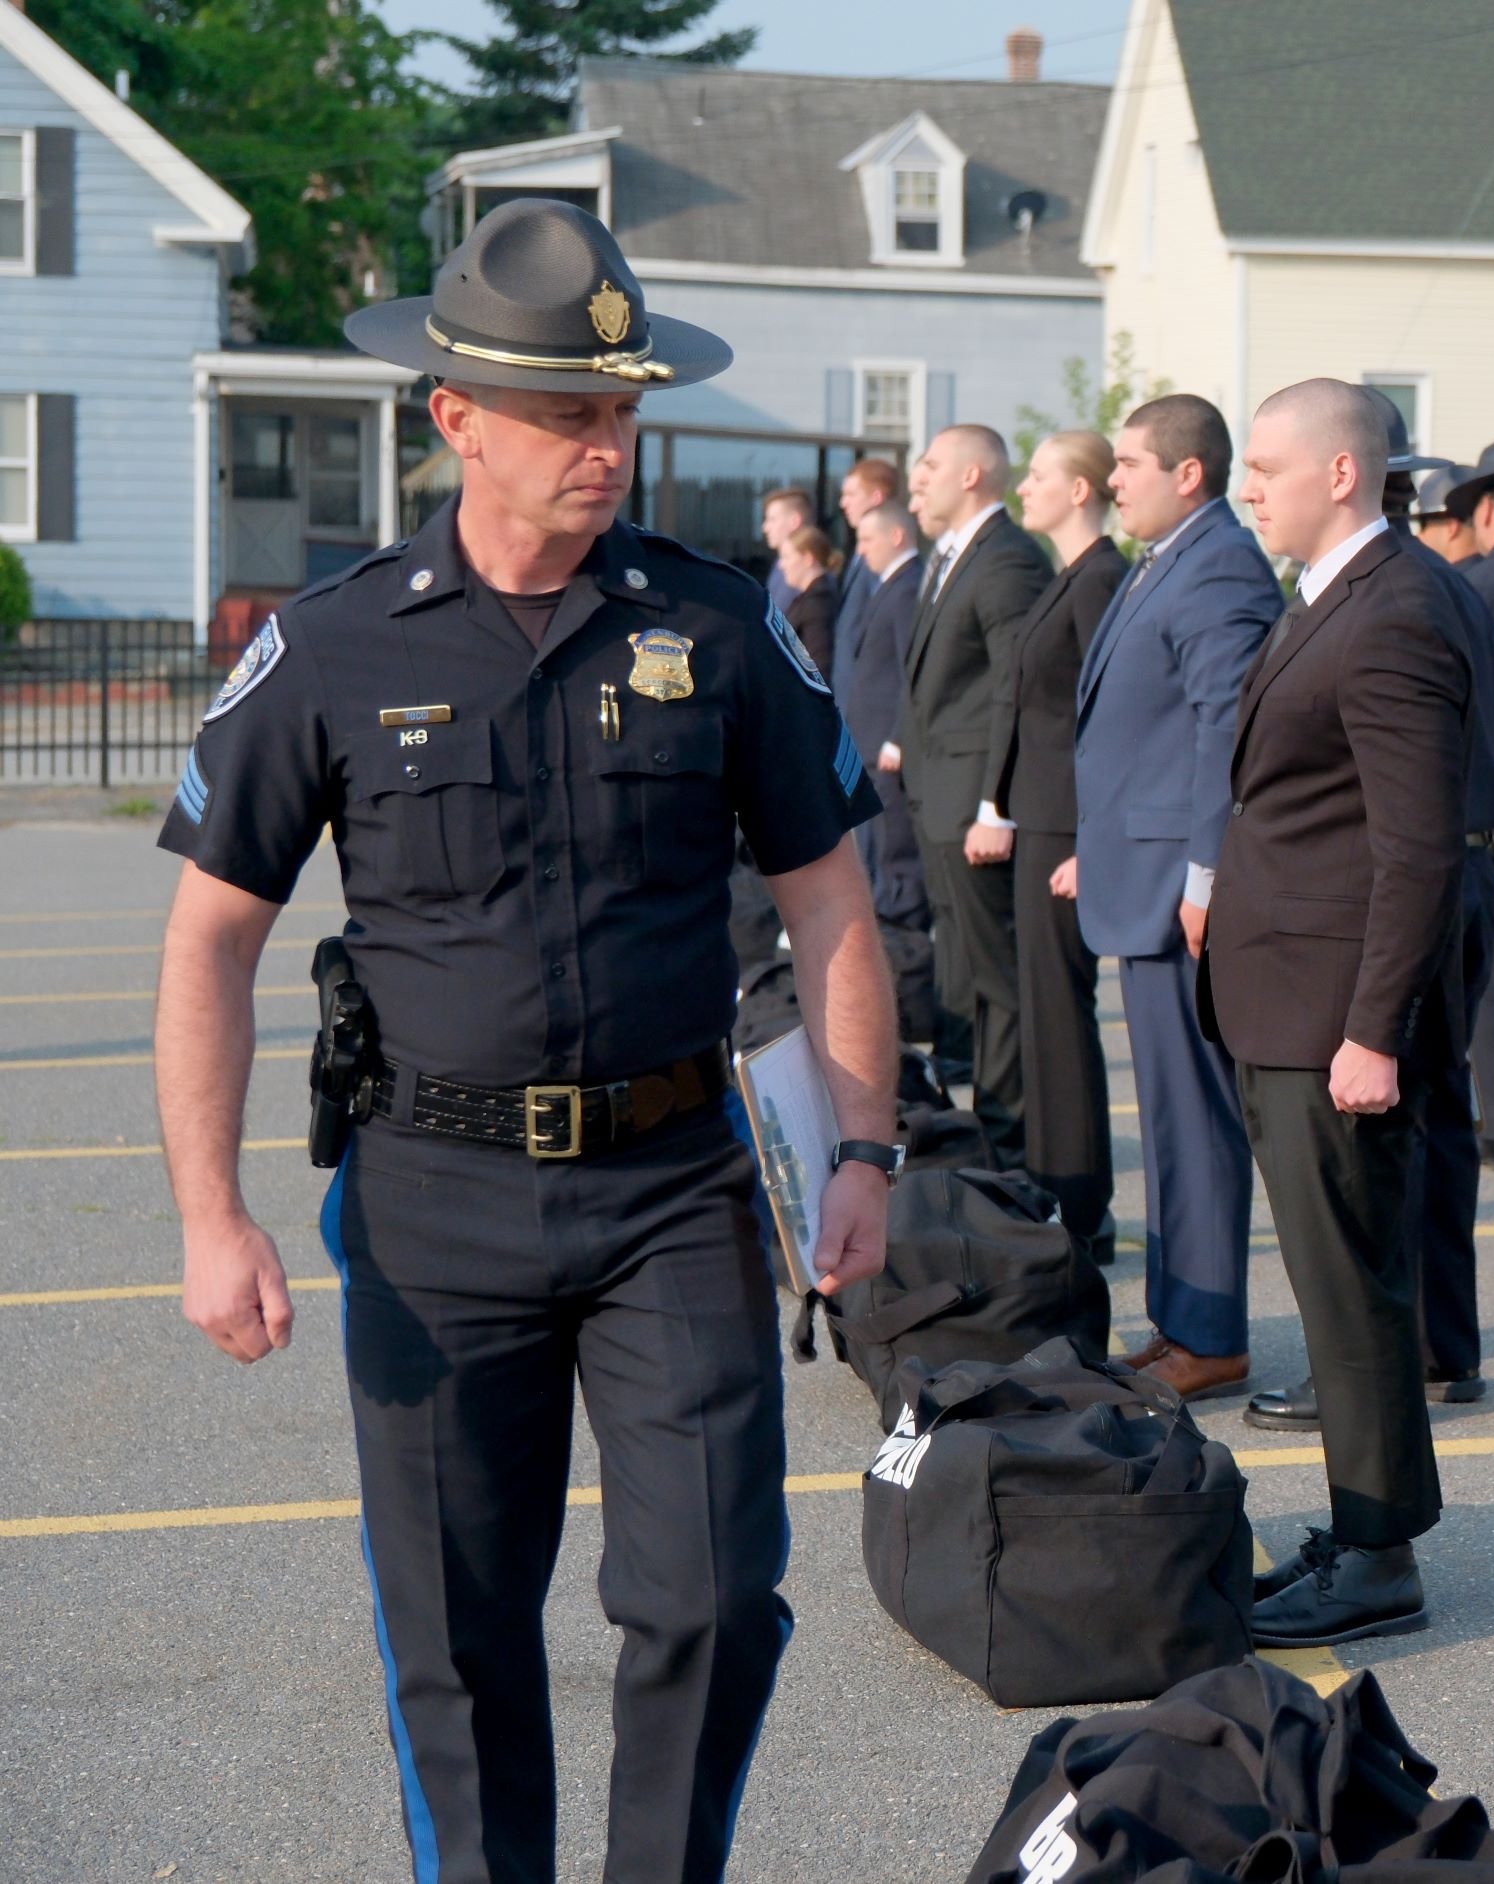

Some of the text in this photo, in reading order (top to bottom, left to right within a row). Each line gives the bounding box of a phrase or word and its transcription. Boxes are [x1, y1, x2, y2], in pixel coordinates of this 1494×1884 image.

[644, 645, 682, 656] POLICE
[404, 710, 429, 721] TOCCI
[400, 729, 428, 746] K-9
